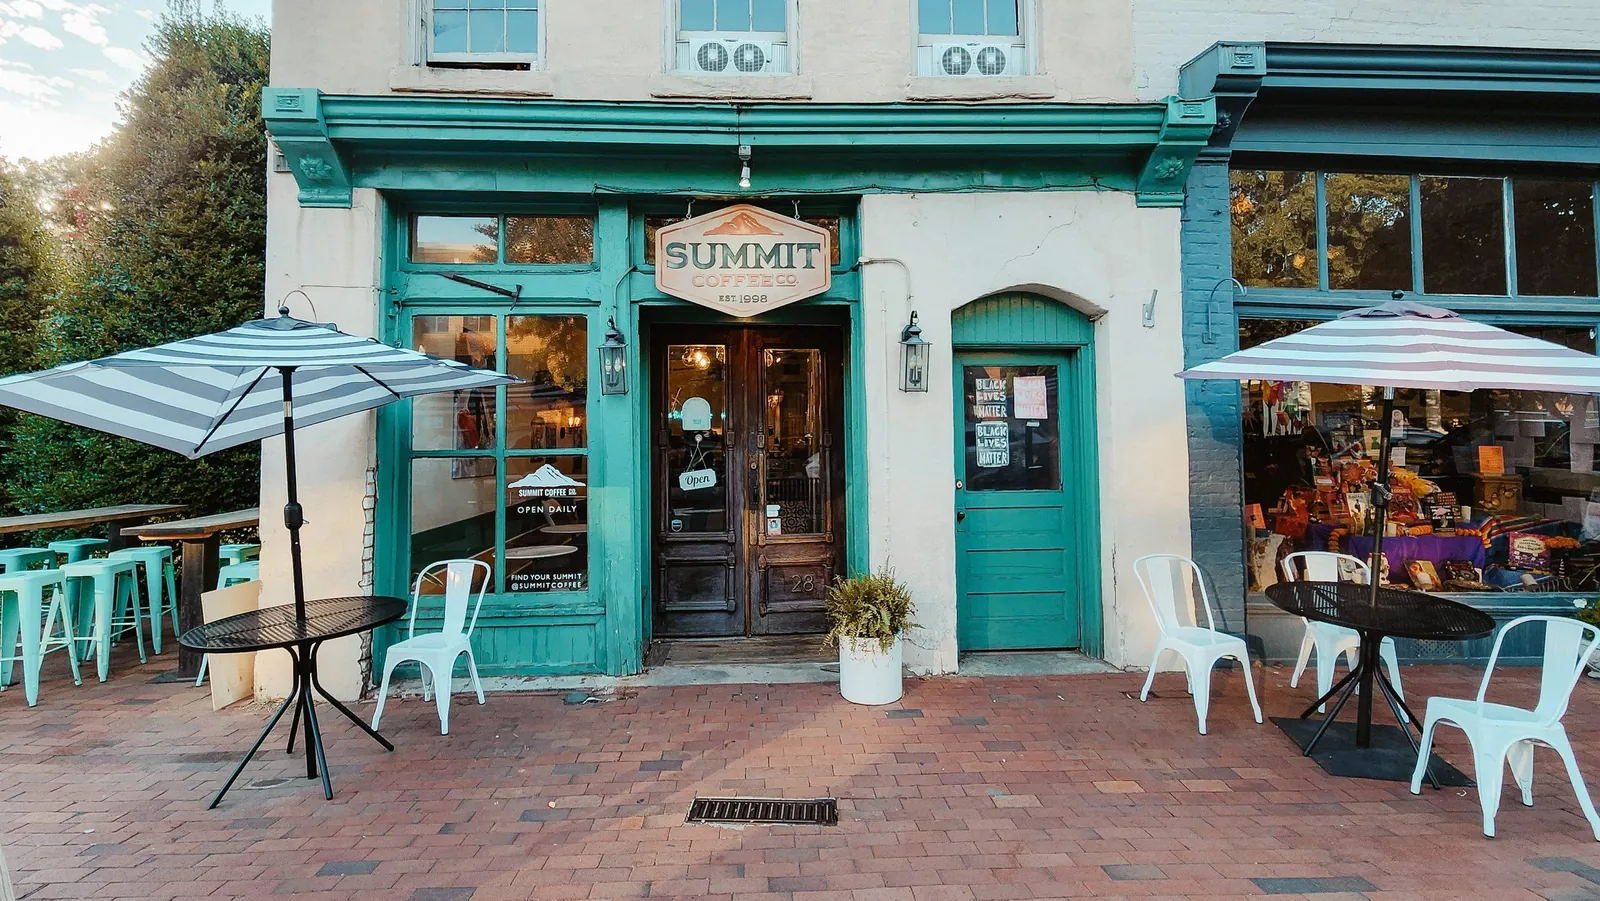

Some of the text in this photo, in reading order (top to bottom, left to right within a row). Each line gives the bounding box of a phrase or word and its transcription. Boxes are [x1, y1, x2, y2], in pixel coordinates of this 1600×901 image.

[665, 242, 821, 269] SUMMIT
[691, 273, 799, 287] COFFEE CO.
[739, 294, 768, 304] 1998
[976, 378, 1007, 390] BLACK
[976, 391, 1007, 402] LIVES
[977, 405, 1008, 418] MATTER
[977, 426, 1007, 437] BLACK
[978, 438, 1007, 448] LIVES
[979, 452, 1008, 465] MATTER
[685, 475, 710, 487] Open
[518, 489, 543, 497] SUMMIT
[544, 488, 567, 496] COFFEE
[517, 505, 577, 514] OPEN DAILY
[511, 581, 582, 591] @SUMMITCOFFEE
[791, 574, 814, 592] 28
